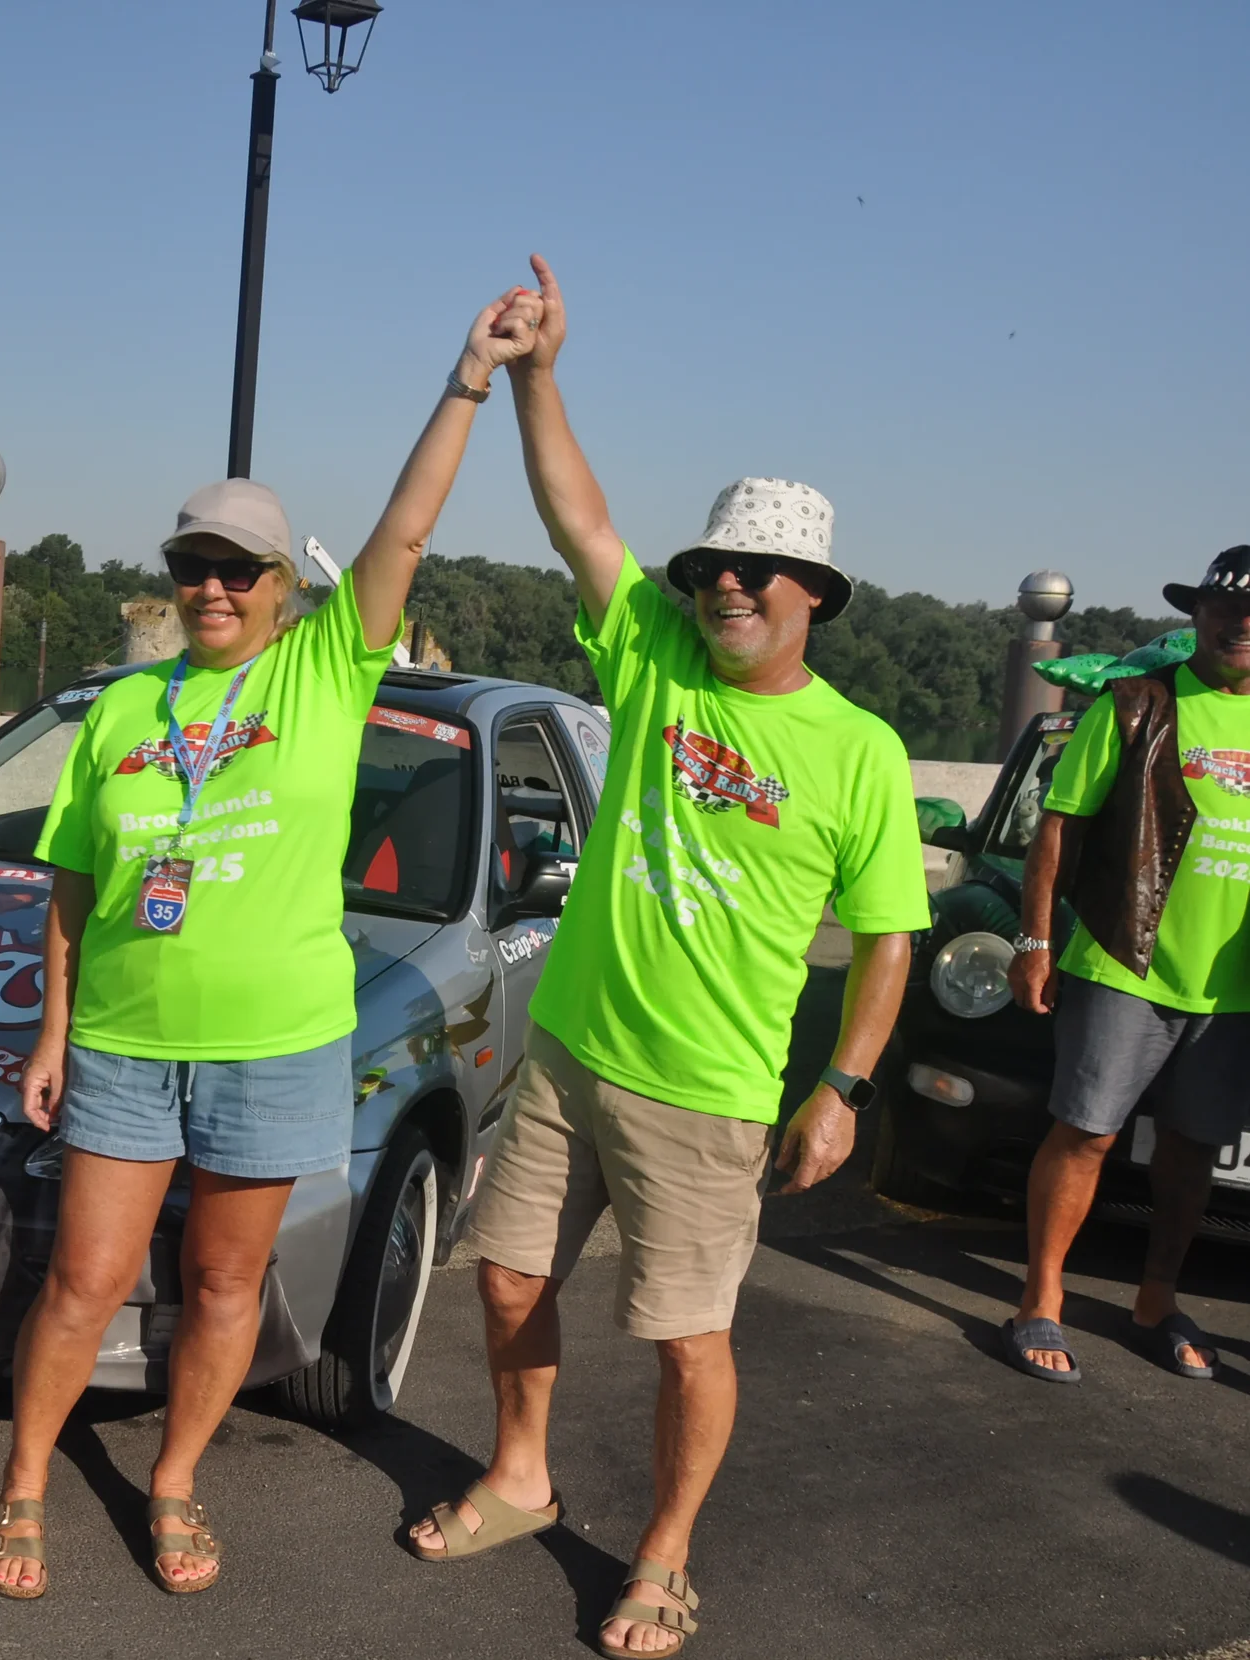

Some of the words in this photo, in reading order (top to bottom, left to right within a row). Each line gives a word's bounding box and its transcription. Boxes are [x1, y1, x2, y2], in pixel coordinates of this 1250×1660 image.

[218, 731, 251, 752] ally
[1201, 759, 1246, 780] Wacky
[713, 773, 761, 802] Rally
[153, 818, 279, 850] Brcelona
[1193, 856, 1250, 882] 202
[152, 903, 175, 921] 35
